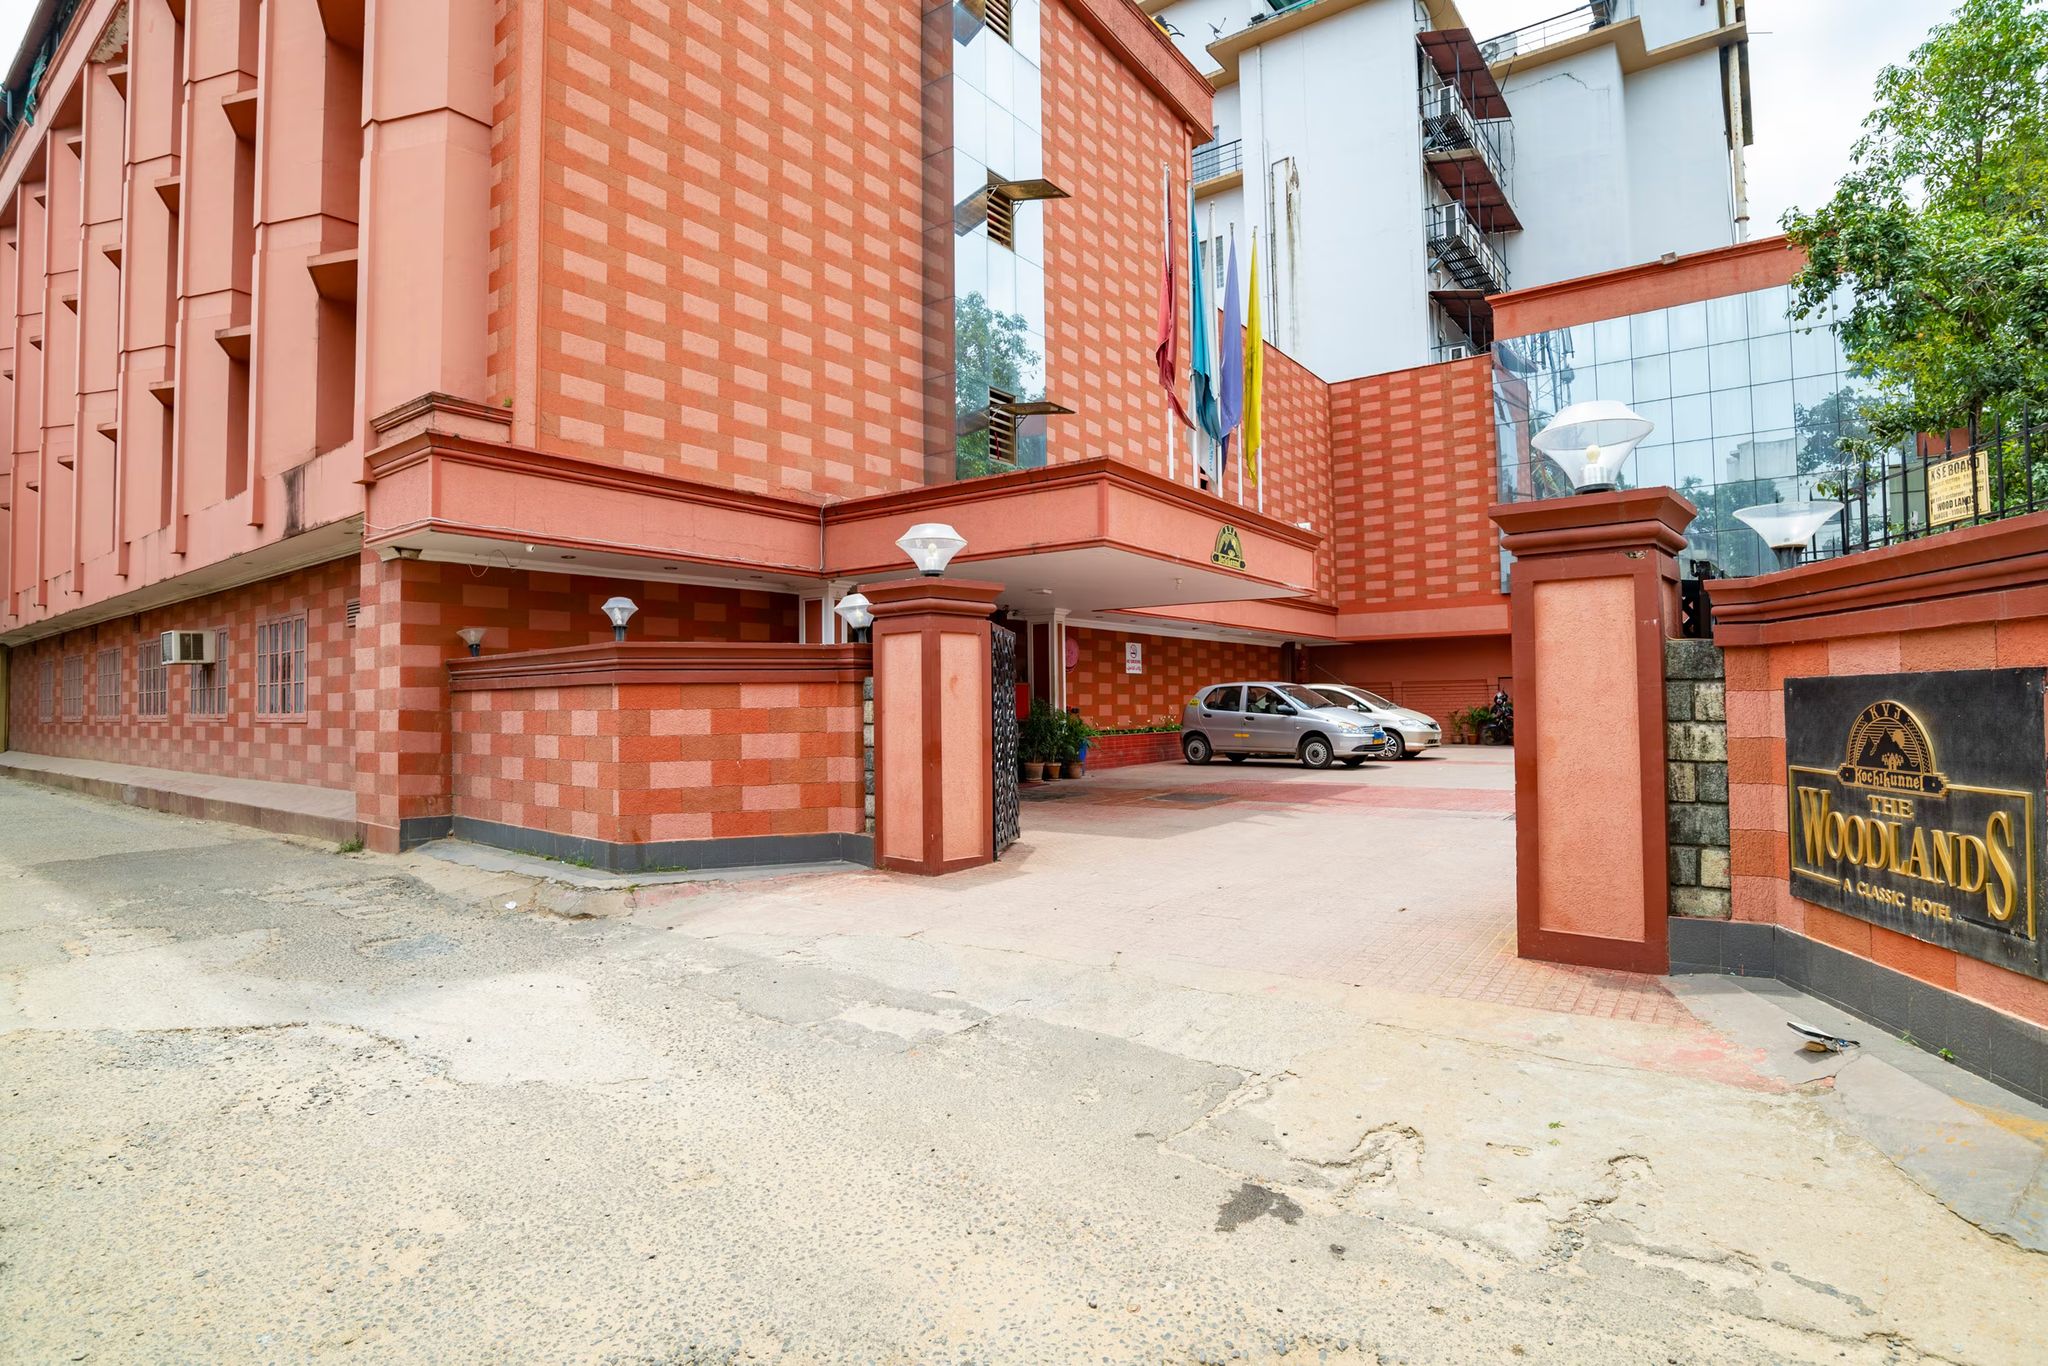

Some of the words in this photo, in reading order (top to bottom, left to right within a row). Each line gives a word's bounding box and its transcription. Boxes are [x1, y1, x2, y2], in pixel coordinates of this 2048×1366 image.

[1869, 703, 1902, 720] KVJ
[1868, 795, 1914, 819] THE
[1798, 786, 2016, 920] WOODLANDS
[1843, 878, 1853, 893] A
[1856, 880, 1906, 907] CLASSIC
[1911, 896, 1953, 922] HOTEL
